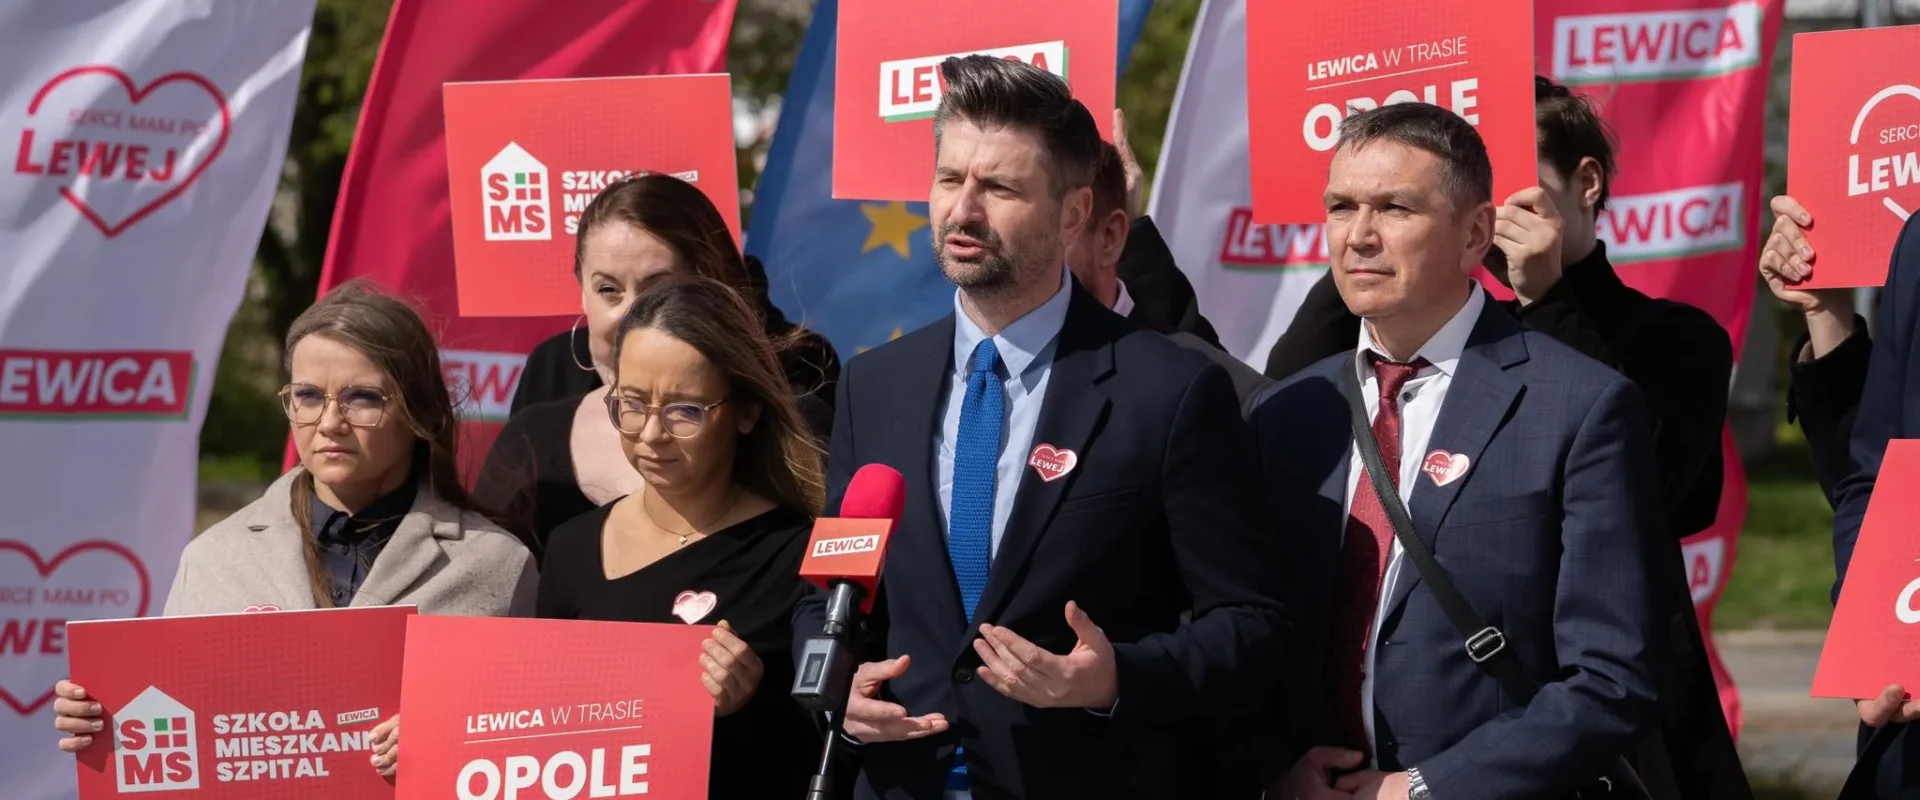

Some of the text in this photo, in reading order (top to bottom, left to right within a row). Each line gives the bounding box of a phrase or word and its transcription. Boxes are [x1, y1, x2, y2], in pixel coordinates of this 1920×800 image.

[1567, 18, 1743, 66] LEWICA
[1308, 36, 1467, 81] LEWICA W TRASIE
[130, 114, 174, 134] MAM
[1880, 124, 1920, 144] SERC
[15, 128, 176, 183] LEWEJ
[490, 204, 545, 233] MS
[1595, 195, 1732, 245] WICA
[1031, 455, 1064, 473] LEWEJ
[817, 538, 873, 554] LEWICA
[43, 588, 95, 605] MAM
[99, 588, 131, 607] PO
[213, 709, 377, 734] SZKOŁA LEWICA
[466, 699, 644, 734] LEWICA W TRASIE
[215, 731, 371, 758] MIESZKANI
[124, 752, 192, 785] MS
[216, 757, 329, 782] SZPITAL
[456, 744, 651, 800] OPOLE
